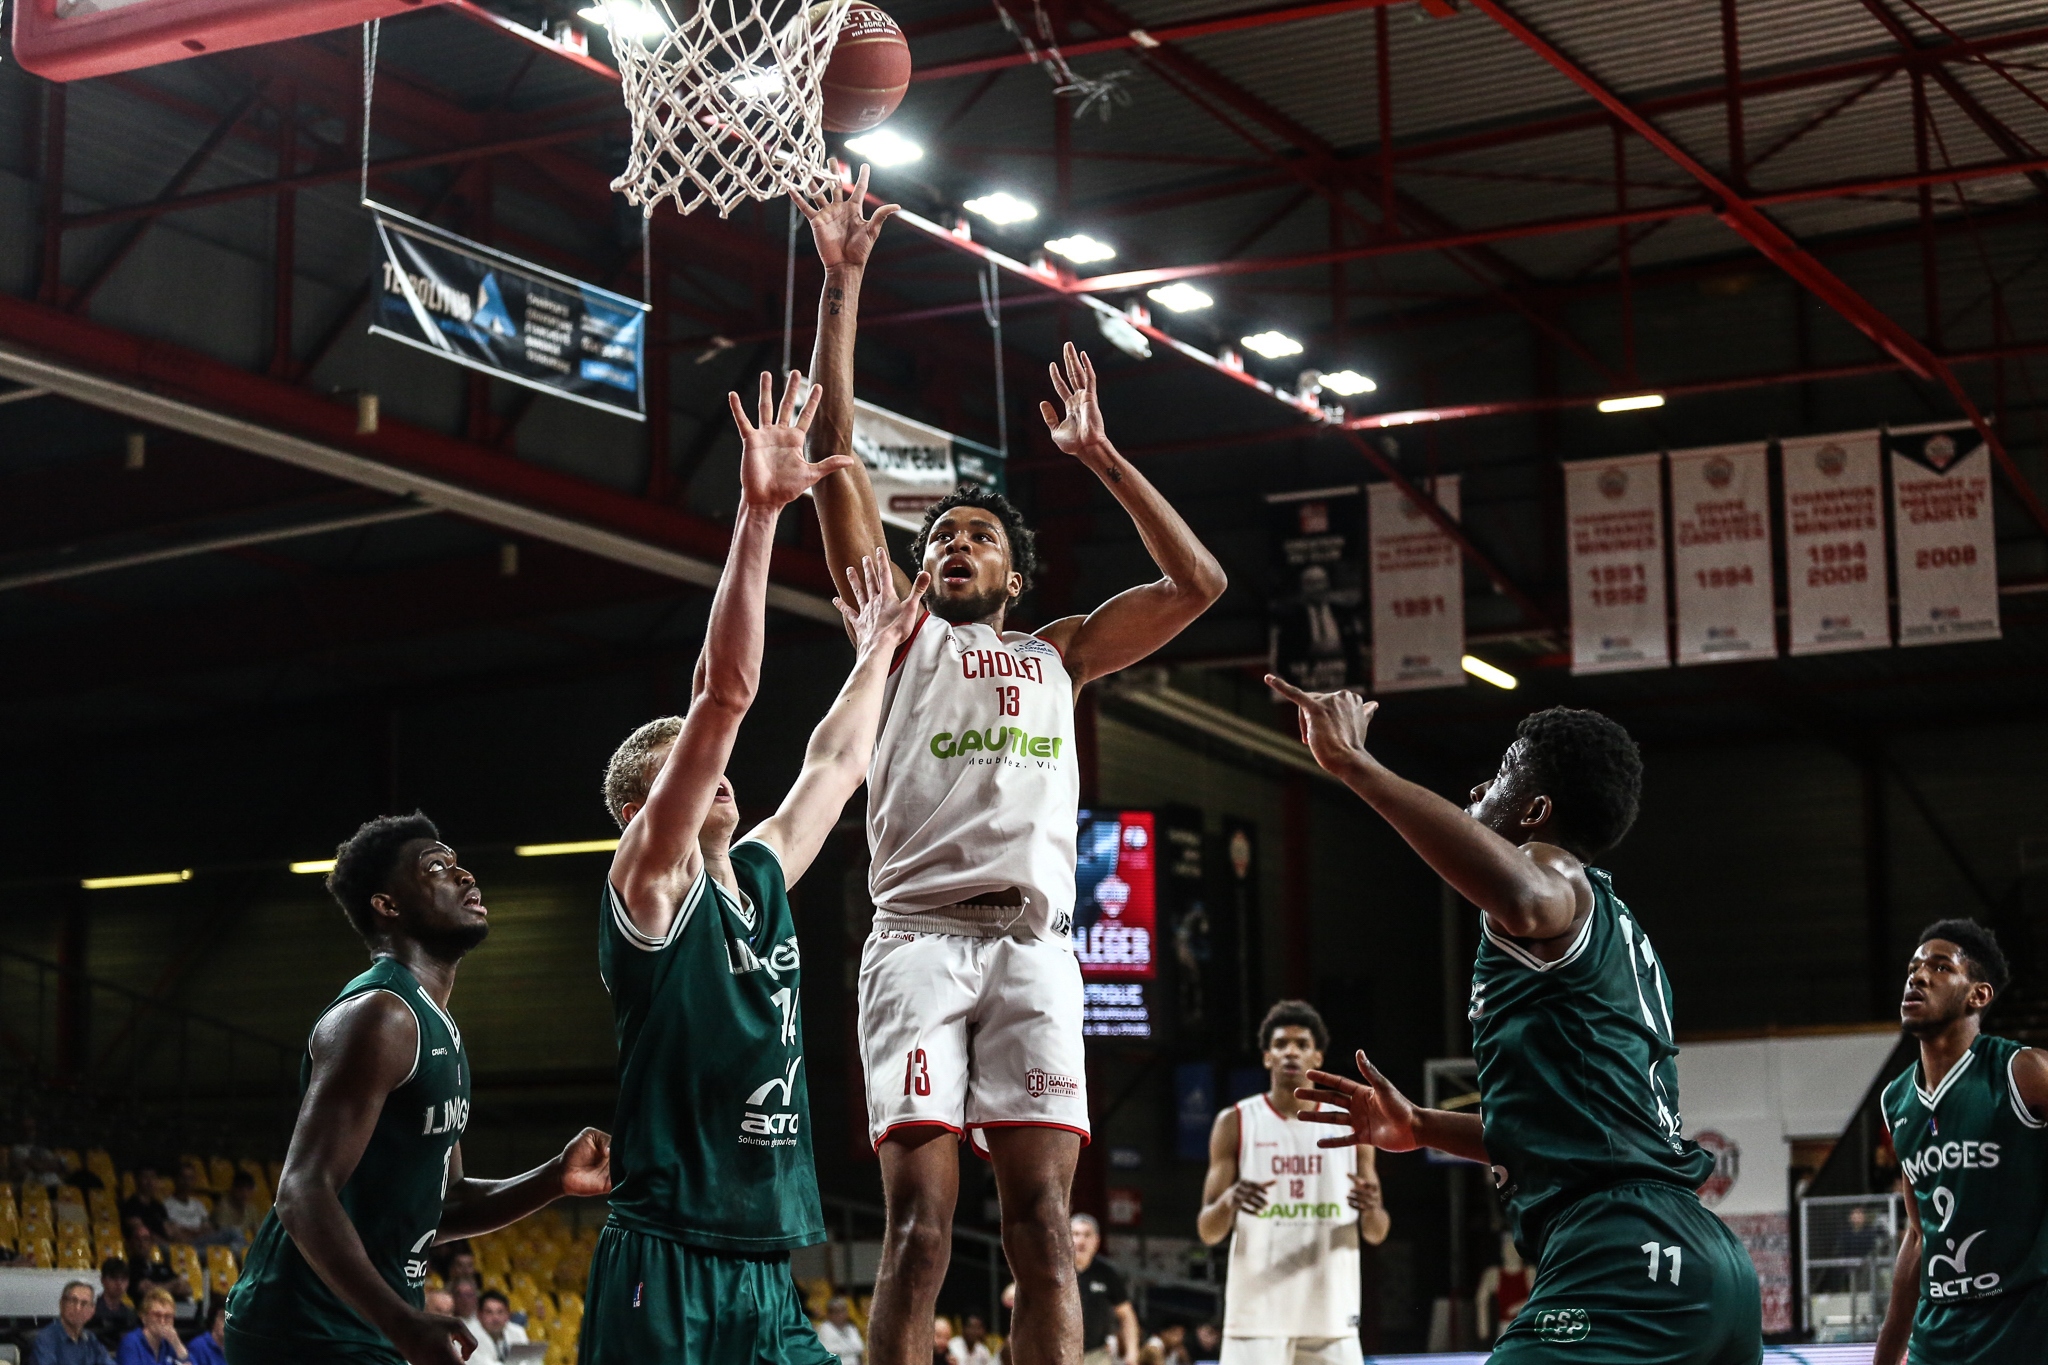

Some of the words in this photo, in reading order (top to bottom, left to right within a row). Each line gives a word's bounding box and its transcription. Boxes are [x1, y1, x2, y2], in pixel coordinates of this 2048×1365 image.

[1809, 541, 1866, 562] 1994
[1917, 545, 1977, 569] 2008
[1696, 566, 1753, 587] 1994
[1808, 564, 1867, 585] 2008
[962, 650, 1043, 684] CHOLET
[996, 686, 1020, 716] 13
[904, 1048, 931, 1096] 13
[1028, 1075, 1044, 1091] CB
[1271, 1155, 1323, 1175] CHOLET
[1290, 1179, 1304, 1199] 12
[1932, 1186, 1955, 1232] 9
[1641, 1242, 1682, 1286] 11
